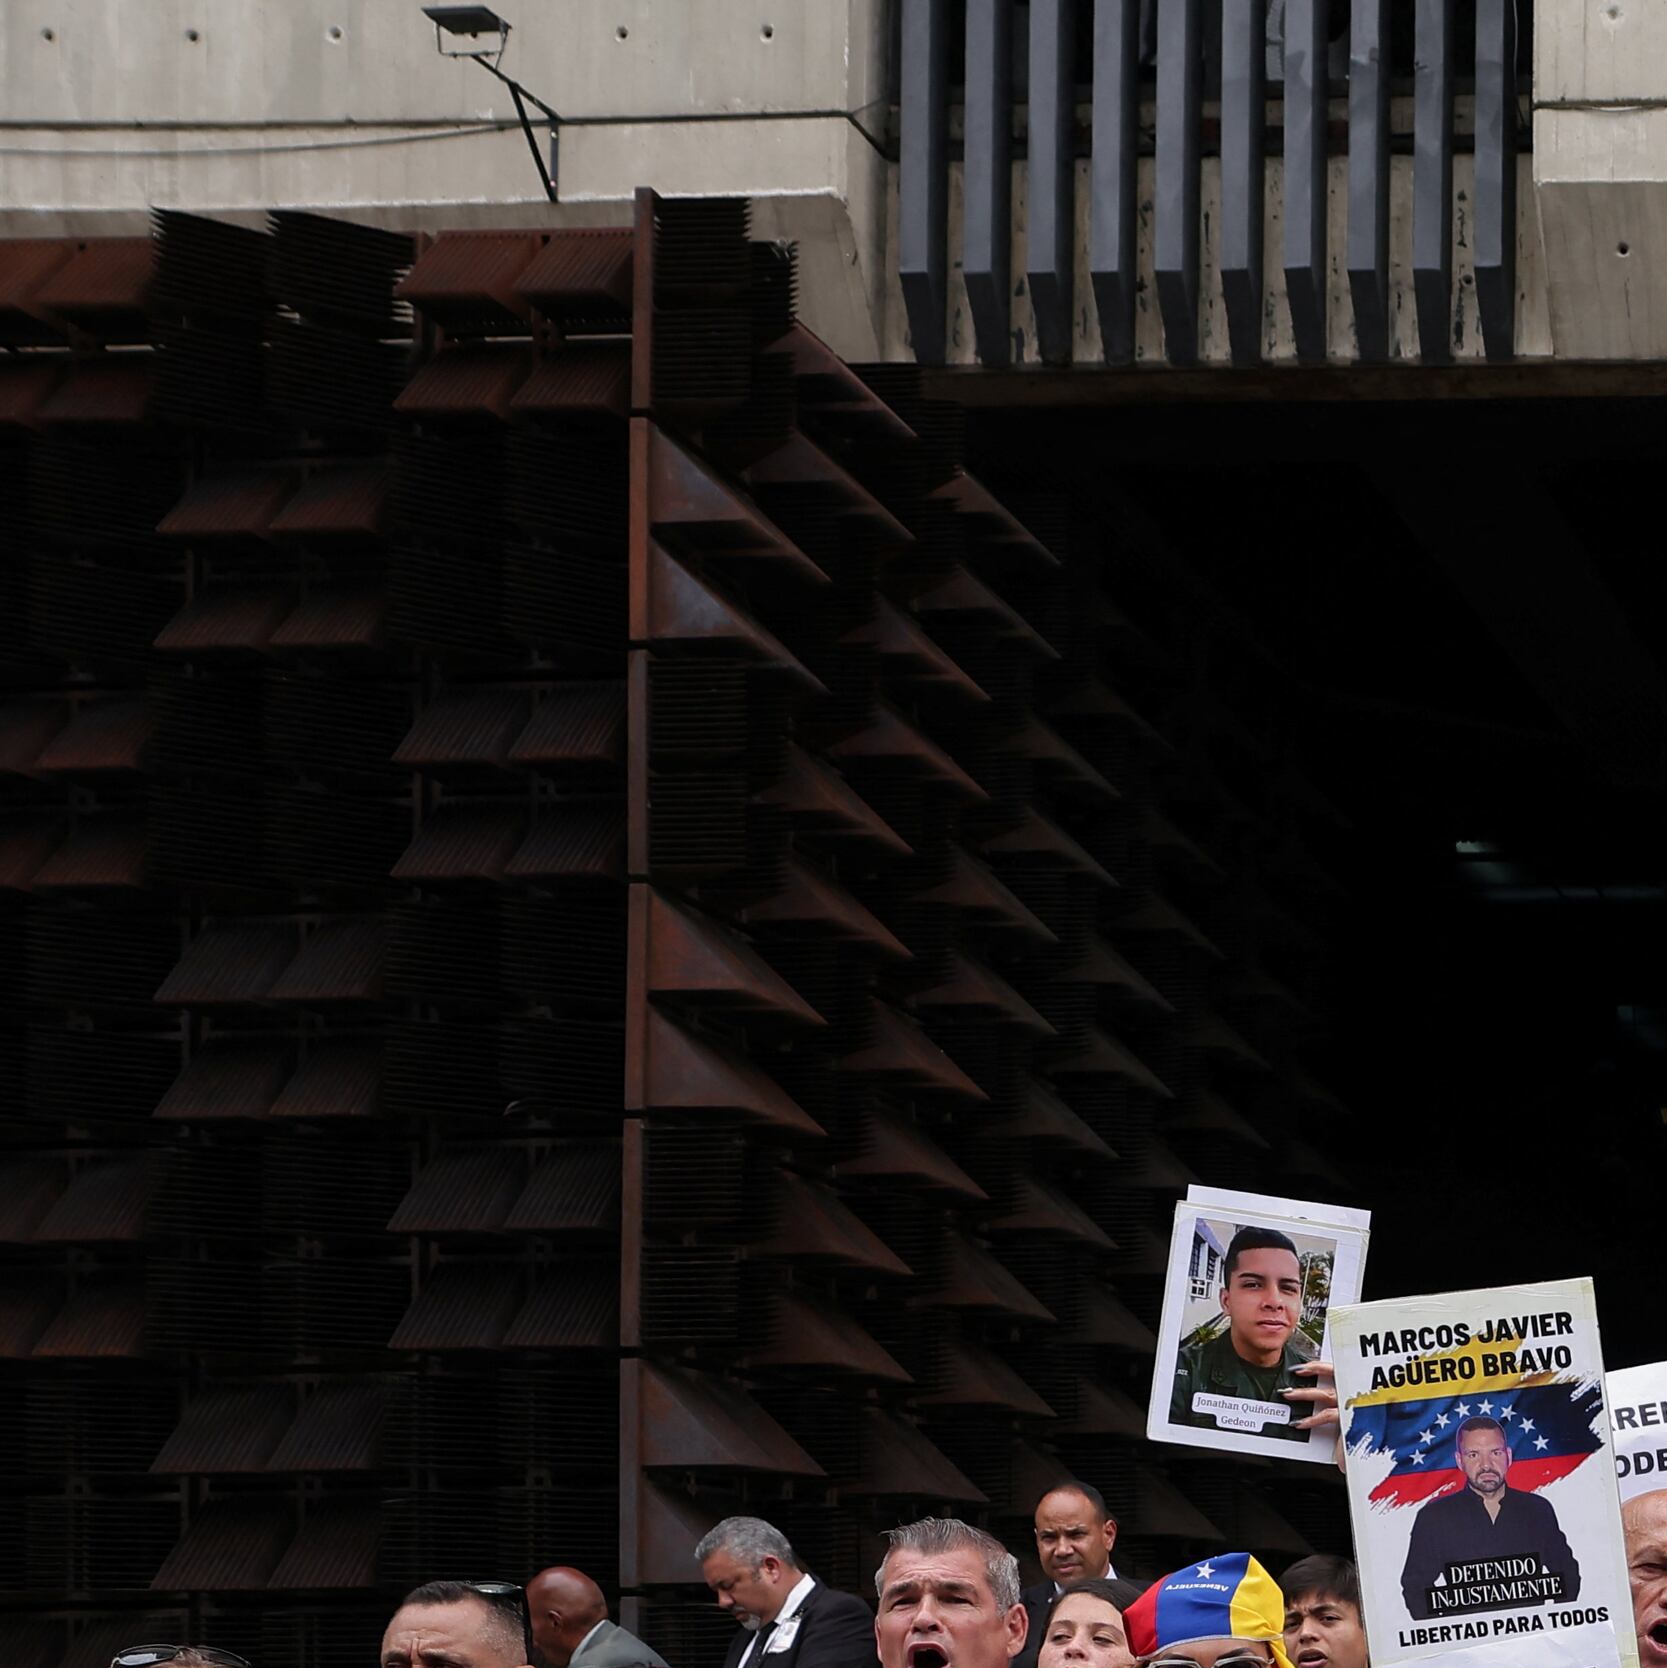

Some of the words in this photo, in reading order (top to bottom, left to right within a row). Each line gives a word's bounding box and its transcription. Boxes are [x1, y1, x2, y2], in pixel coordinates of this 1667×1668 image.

[1359, 1322, 1471, 1358] MARCOS
[1478, 1311, 1575, 1343] JAVIER
[1371, 1355, 1476, 1390] AGÜERO
[1482, 1345, 1573, 1377] BRAVO
[1196, 1397, 1240, 1411] Jonathan
[1221, 1415, 1256, 1428] Gedeon
[1450, 1557, 1537, 1584] DETENIDO
[1431, 1577, 1562, 1609] INJUSTAMENTE
[1399, 1621, 1489, 1647] LIBERTAD
[1493, 1614, 1544, 1635] PARA
[1548, 1607, 1609, 1629] TODOS
